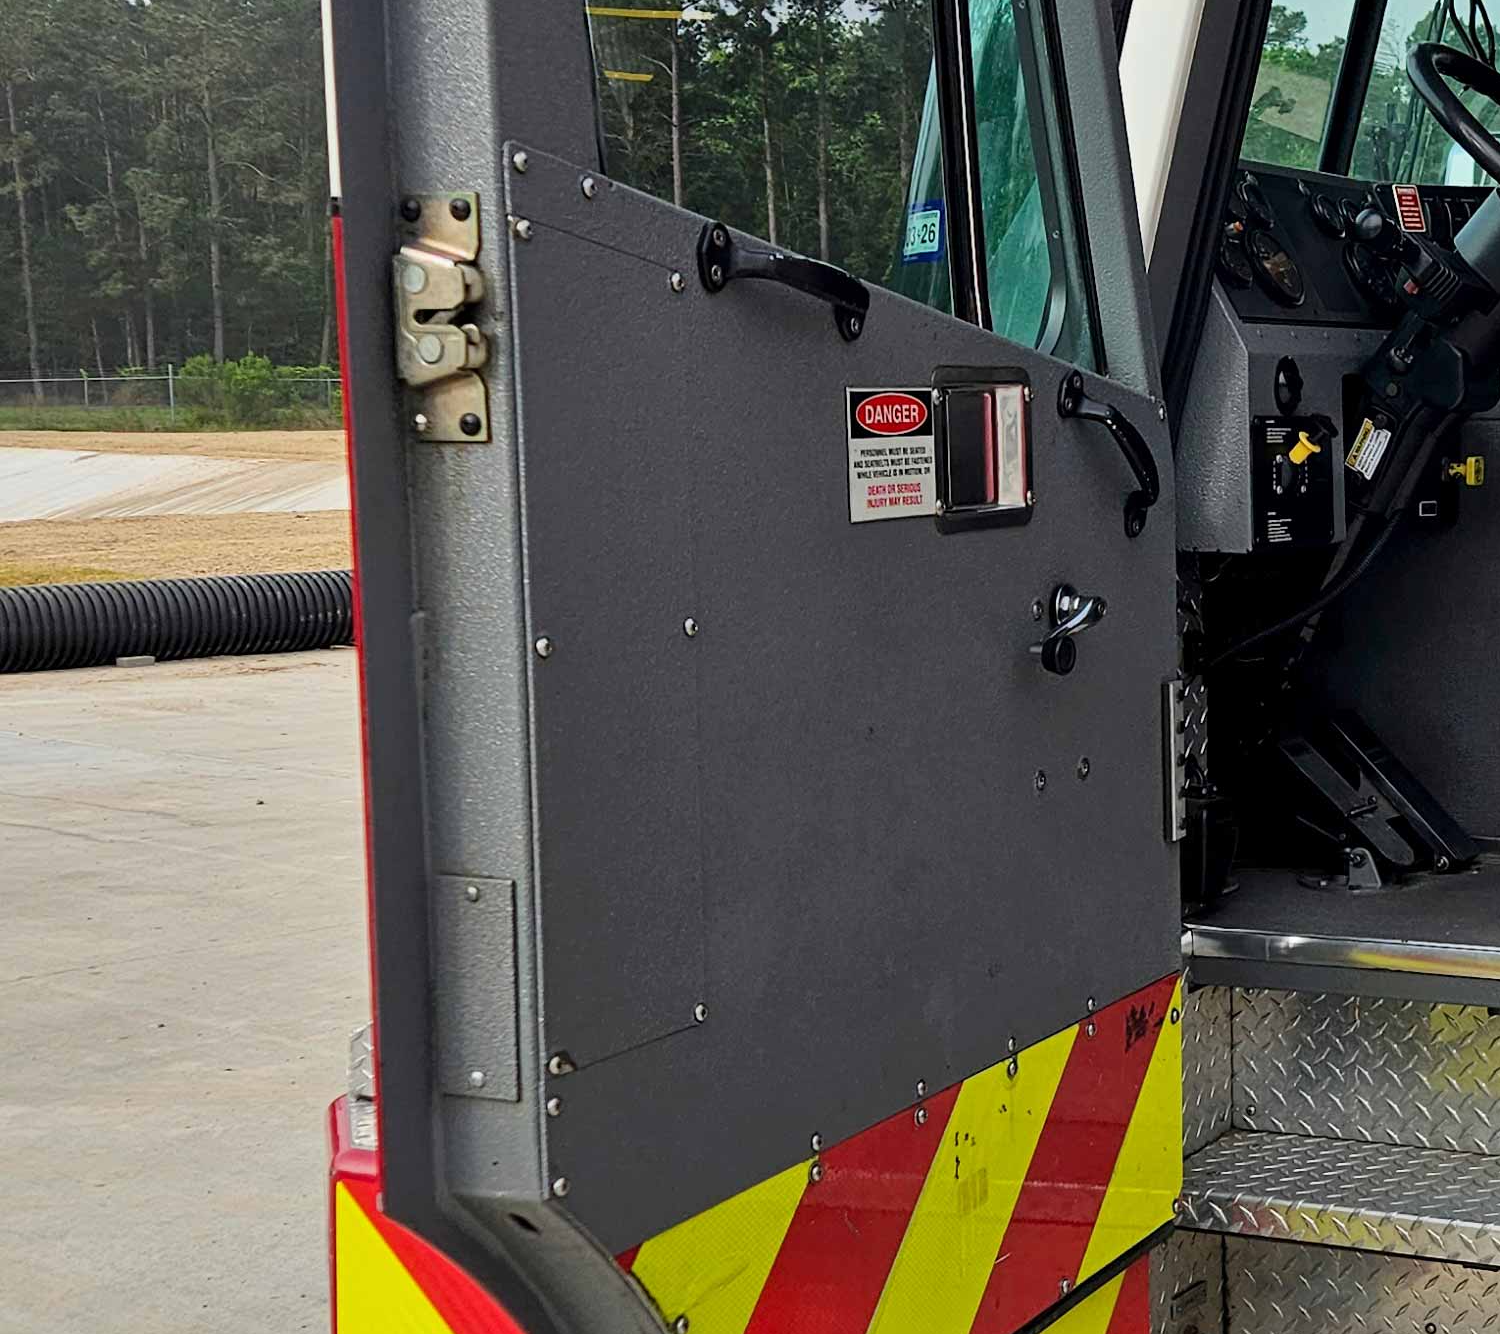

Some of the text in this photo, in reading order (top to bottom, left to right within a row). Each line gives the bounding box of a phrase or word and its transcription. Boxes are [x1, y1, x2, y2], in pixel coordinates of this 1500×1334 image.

[865, 404, 919, 424] DANGER
[888, 447, 902, 456] MUST
[902, 446, 909, 455] BE
[853, 460, 864, 468] AND
[890, 457, 903, 466] MUST
[904, 457, 910, 465] BE
[867, 482, 921, 496] DEATH OR SERIOUS
[867, 495, 923, 508] INJURY MAY RESULT
